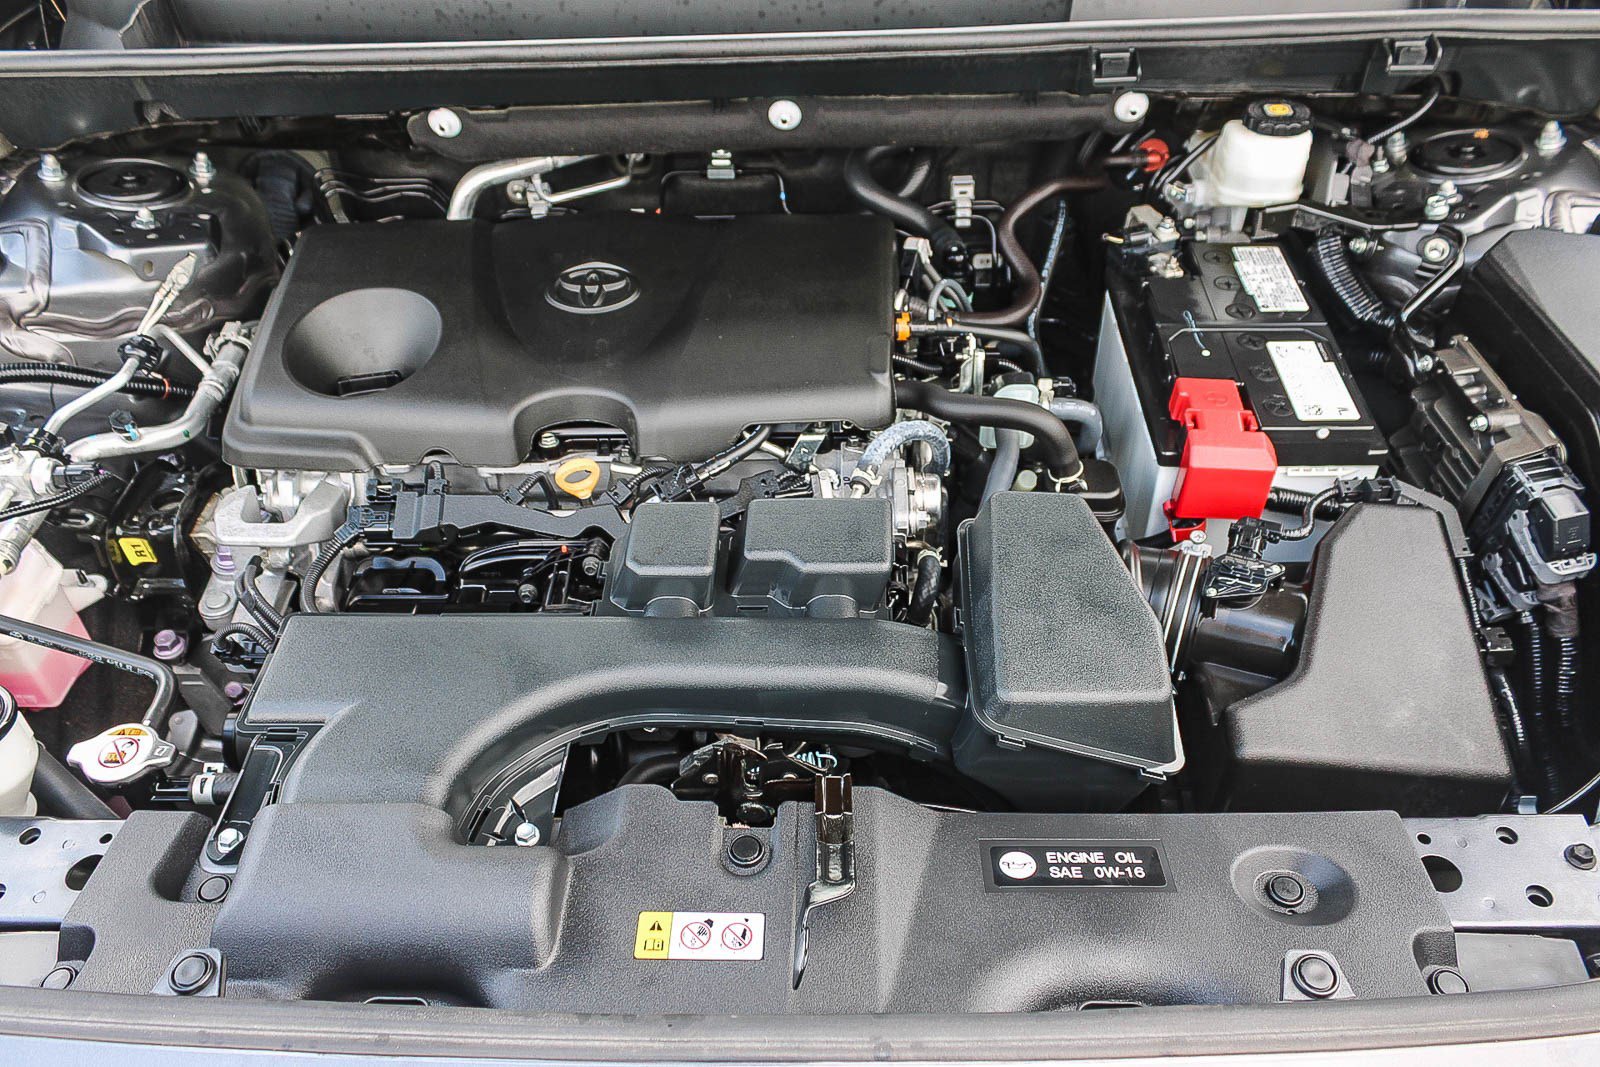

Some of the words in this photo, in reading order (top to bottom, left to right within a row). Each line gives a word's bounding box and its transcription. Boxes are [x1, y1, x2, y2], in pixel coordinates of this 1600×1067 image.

[1045, 851, 1106, 864] ENGINE
[1115, 851, 1143, 864] OIL
[1049, 866, 1083, 879] SAE
[1094, 866, 1146, 879] 0W-16
